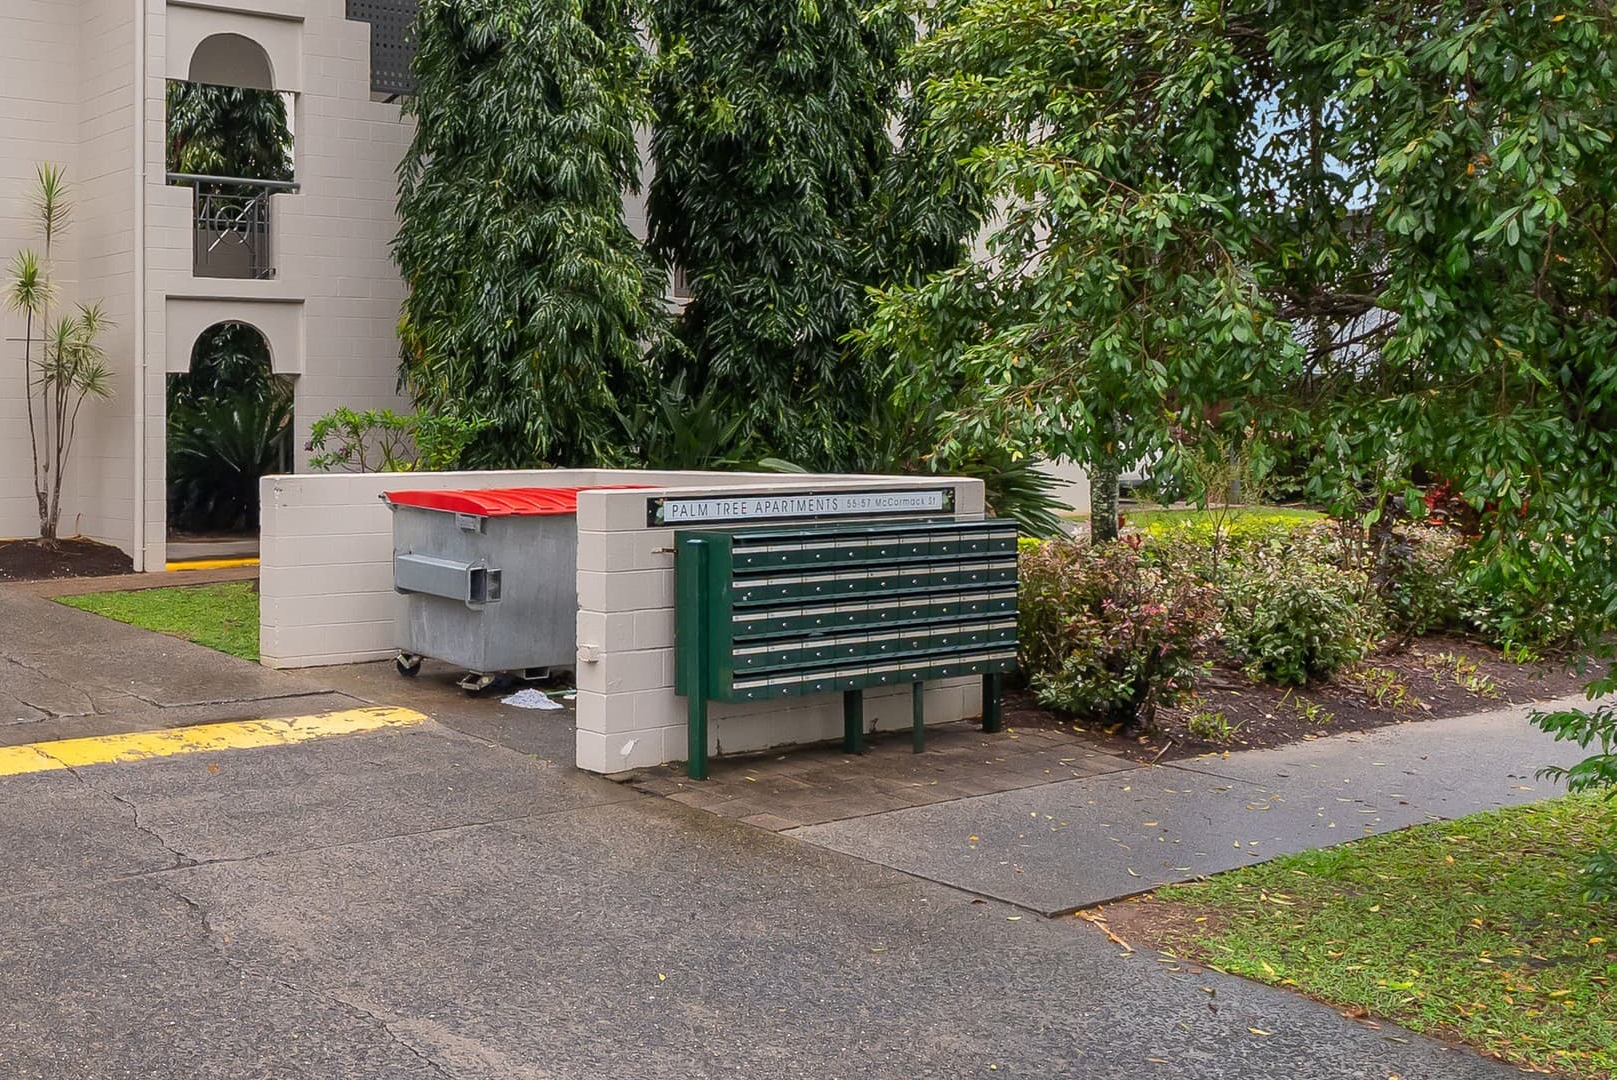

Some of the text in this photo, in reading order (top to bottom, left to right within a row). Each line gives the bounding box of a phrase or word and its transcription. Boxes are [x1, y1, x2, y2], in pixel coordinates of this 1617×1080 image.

[672, 503, 708, 518] PALM
[716, 501, 747, 516] TREE
[755, 498, 838, 513] APARTMENTS
[846, 498, 871, 509] 55-57
[875, 496, 924, 507] McCormack
